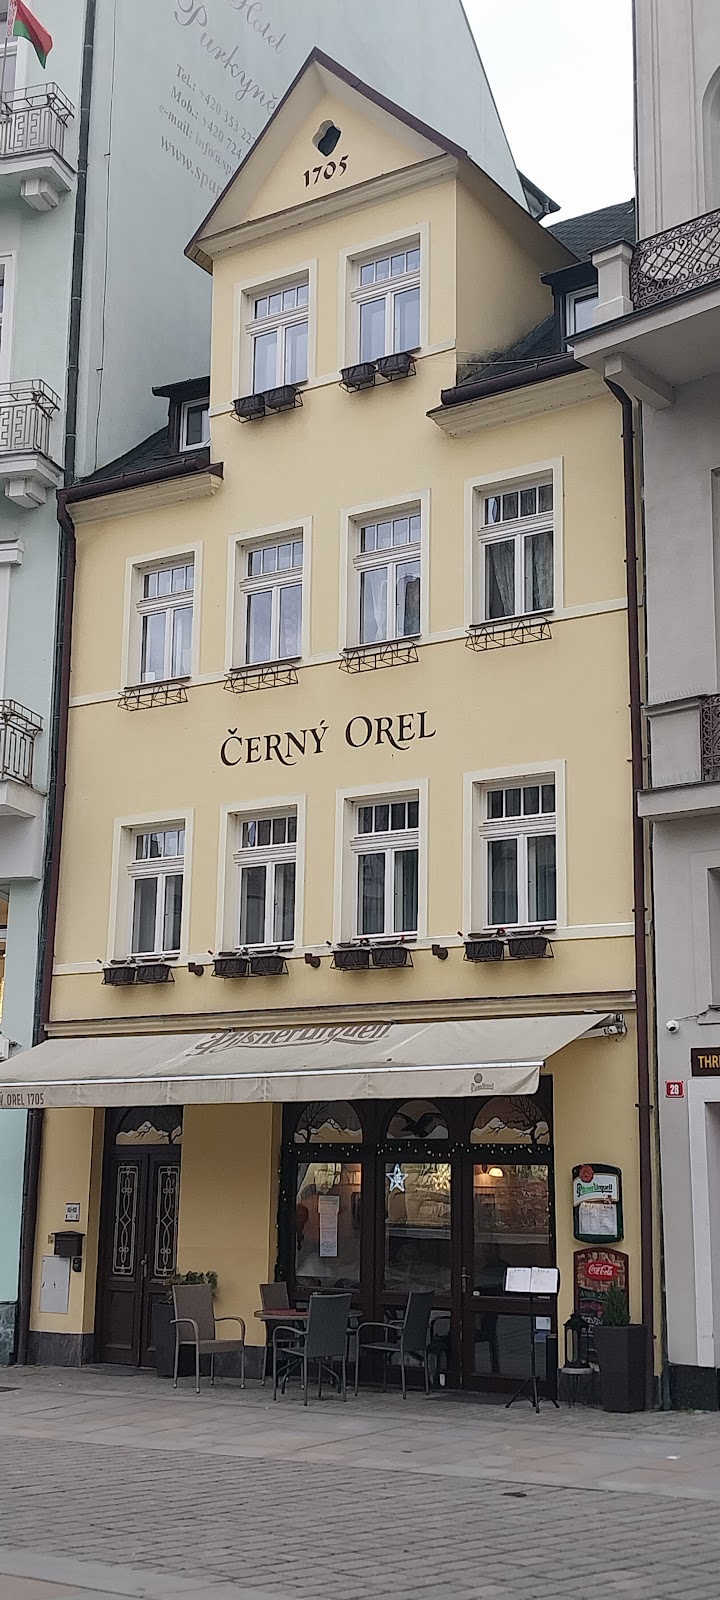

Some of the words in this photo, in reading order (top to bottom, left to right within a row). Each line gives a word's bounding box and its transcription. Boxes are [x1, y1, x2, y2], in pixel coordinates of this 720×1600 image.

[226, 0, 286, 54] Hotel
[174, 0, 279, 116] Purkyně
[159, 104, 193, 139] e-mail:
[170, 85, 199, 120] Mob.:
[202, 115, 224, 143] +420
[226, 137, 242, 160] 724
[176, 64, 196, 92] Tel.:
[199, 87, 222, 115] +420
[223, 109, 239, 132] 353
[303, 154, 349, 188] 1705
[220, 719, 329, 766] ČERNÝ
[345, 710, 437, 750] OREL
[6, 1093, 25, 1105] OREL
[27, 1092, 44, 1105] 1705
[669, 1083, 680, 1095] 28
